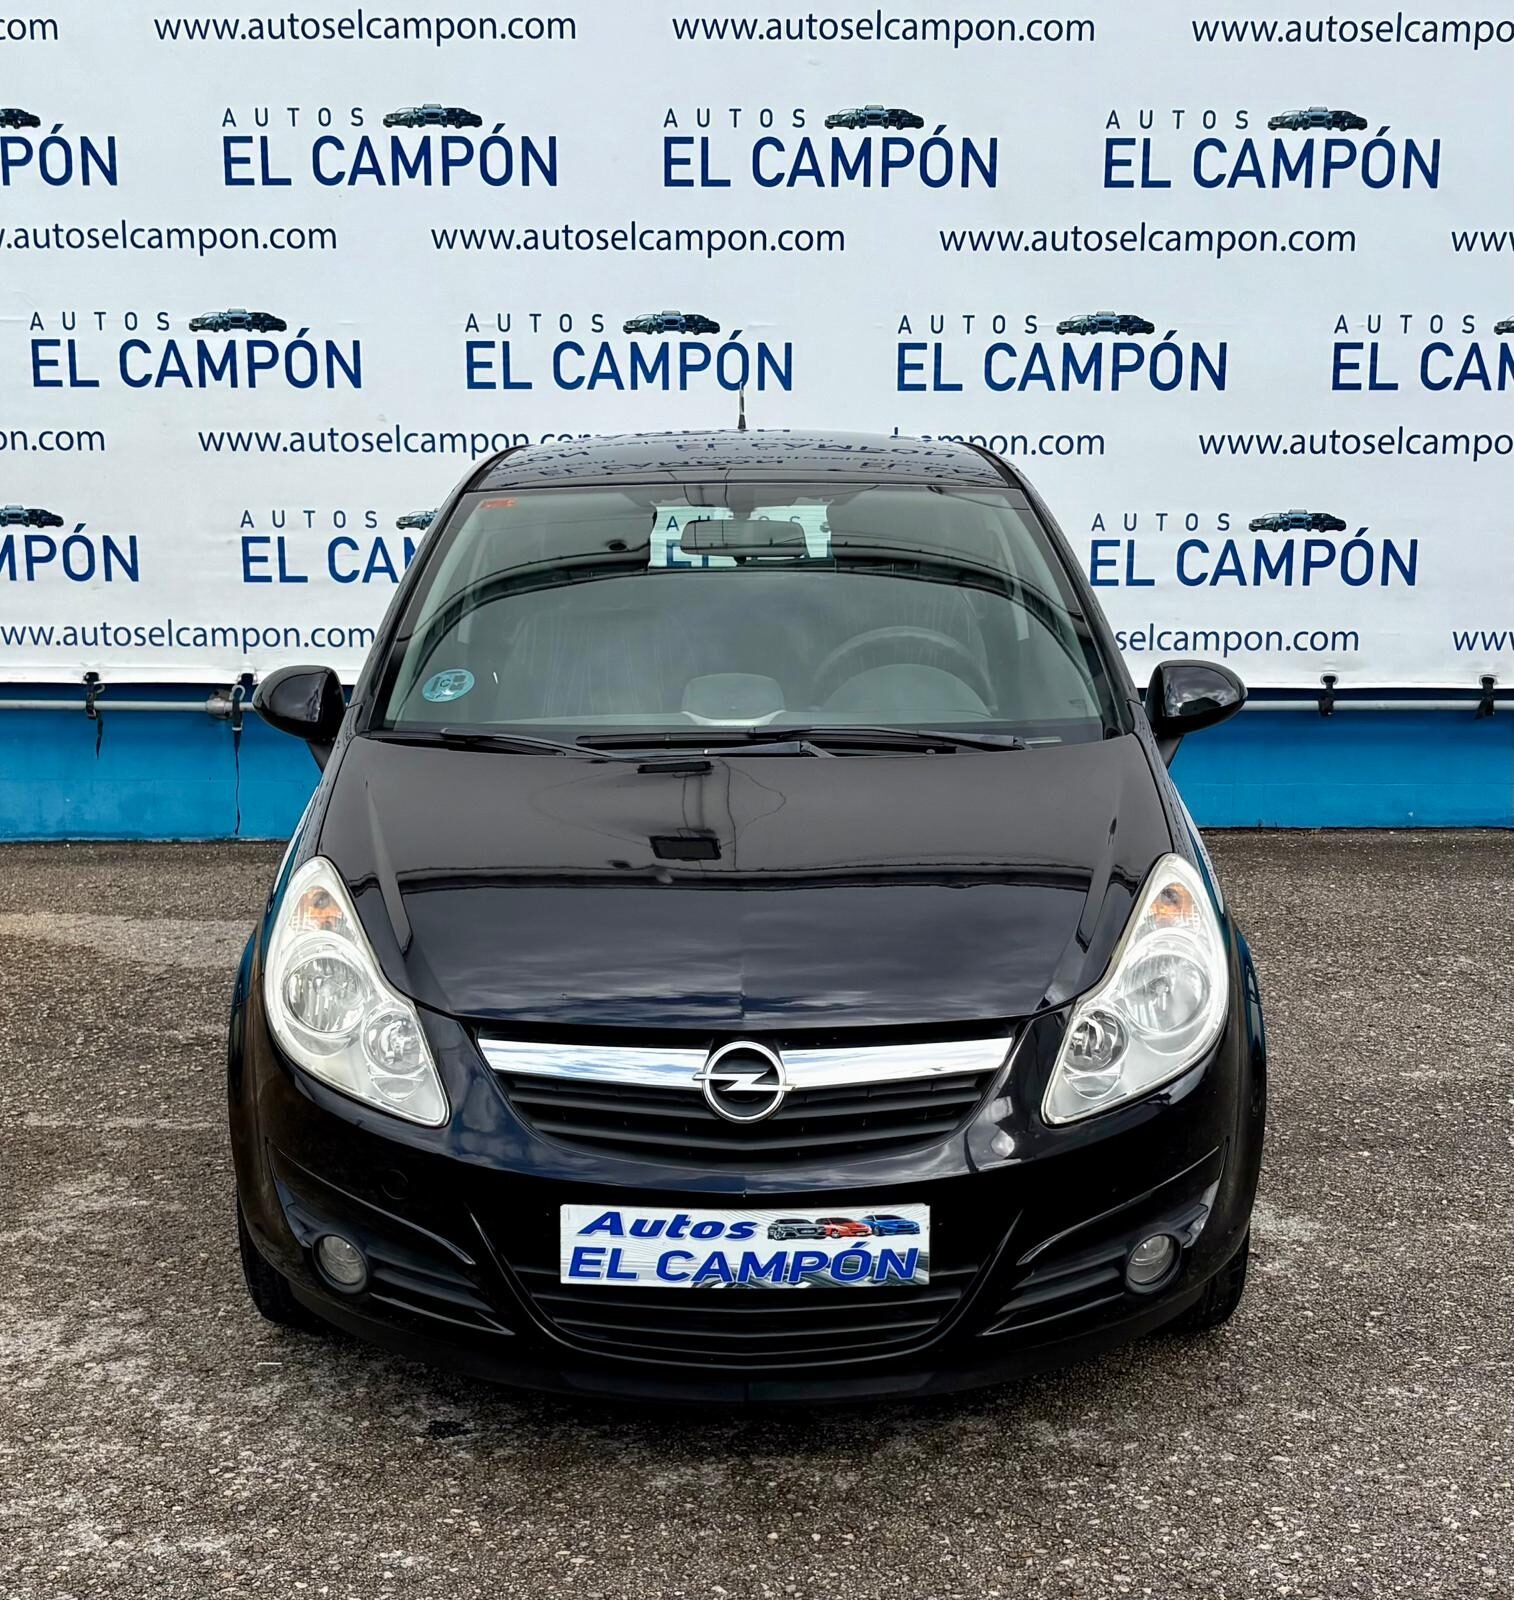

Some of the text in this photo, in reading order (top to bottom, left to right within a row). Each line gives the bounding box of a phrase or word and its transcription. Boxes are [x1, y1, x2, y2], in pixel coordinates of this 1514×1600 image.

[154, 9, 575, 47] www.autoselcampon.com
[672, 10, 1094, 48] www.autoselcampon.com
[222, 107, 363, 127] AUTOS
[664, 108, 805, 128] AUTOS
[1106, 110, 1248, 129] AUTOS
[0, 124, 117, 186] PÓN
[223, 123, 557, 186] EL CAMPÓN
[664, 125, 997, 188] EL CAMPÓN
[1104, 126, 1440, 189] EL CAMPÓN
[0, 220, 336, 256] .autoselcampon.com
[431, 221, 844, 258] www.autoselcampon.com
[940, 222, 1355, 259] www.autoselcampon.com
[1452, 232, 1514, 251] ww
[30, 312, 169, 331] AUTOS
[465, 313, 604, 333] AUTOS
[898, 315, 1037, 334] AUTOS
[1334, 315, 1474, 334] AUTOS
[31, 328, 361, 388] EL CAMPÓN
[466, 330, 792, 391] EL CAMPÓN
[897, 330, 1227, 391] EL CAMPÓN
[1332, 342, 1398, 390] EL
[1199, 426, 1513, 462] www.autoselcampo
[241, 510, 377, 528] AUTOS
[1092, 513, 1229, 531] AUTOS
[242, 536, 308, 583] EL
[1090, 527, 1417, 586] EL CAMPÓN
[1453, 632, 1514, 651] ww
[578, 1211, 757, 1240] Autos
[568, 1242, 918, 1284] EL CAMPÓN
